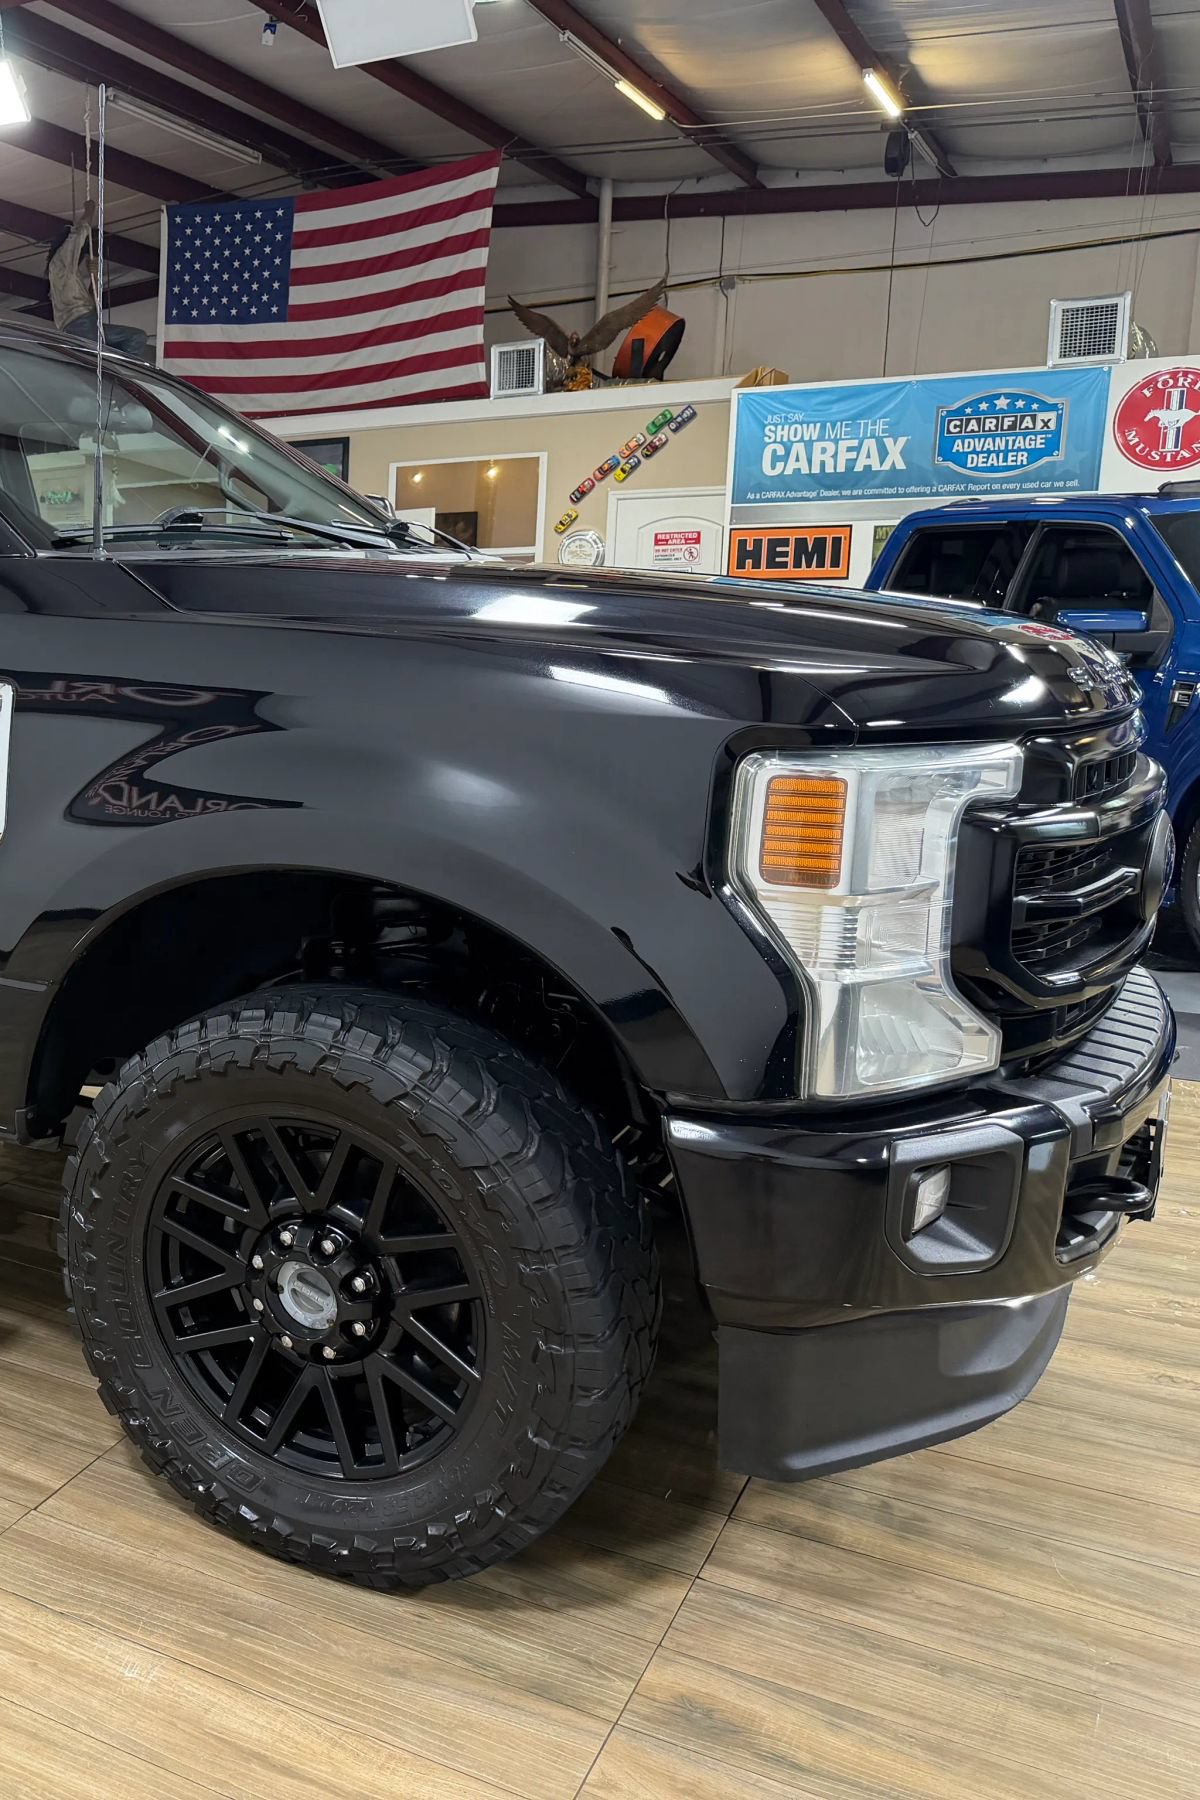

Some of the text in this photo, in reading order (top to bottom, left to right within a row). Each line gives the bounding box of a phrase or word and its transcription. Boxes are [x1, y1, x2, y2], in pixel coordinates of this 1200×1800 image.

[763, 412, 804, 424] JUST SAY
[949, 416, 1053, 434] CARFAX
[763, 418, 890, 443] SHOW ME THE
[951, 434, 1046, 453] ADVANTAGE
[762, 436, 907, 476] CARFAX
[966, 451, 1029, 468] DEALER
[863, 487, 897, 495] committed
[905, 485, 931, 493] offering
[967, 483, 990, 491] Report
[1002, 482, 1020, 490] every
[1022, 481, 1039, 489] used
[1065, 479, 1080, 487] sell.
[735, 535, 843, 571] HEMI
[150, 1386, 266, 1493] OPEN
